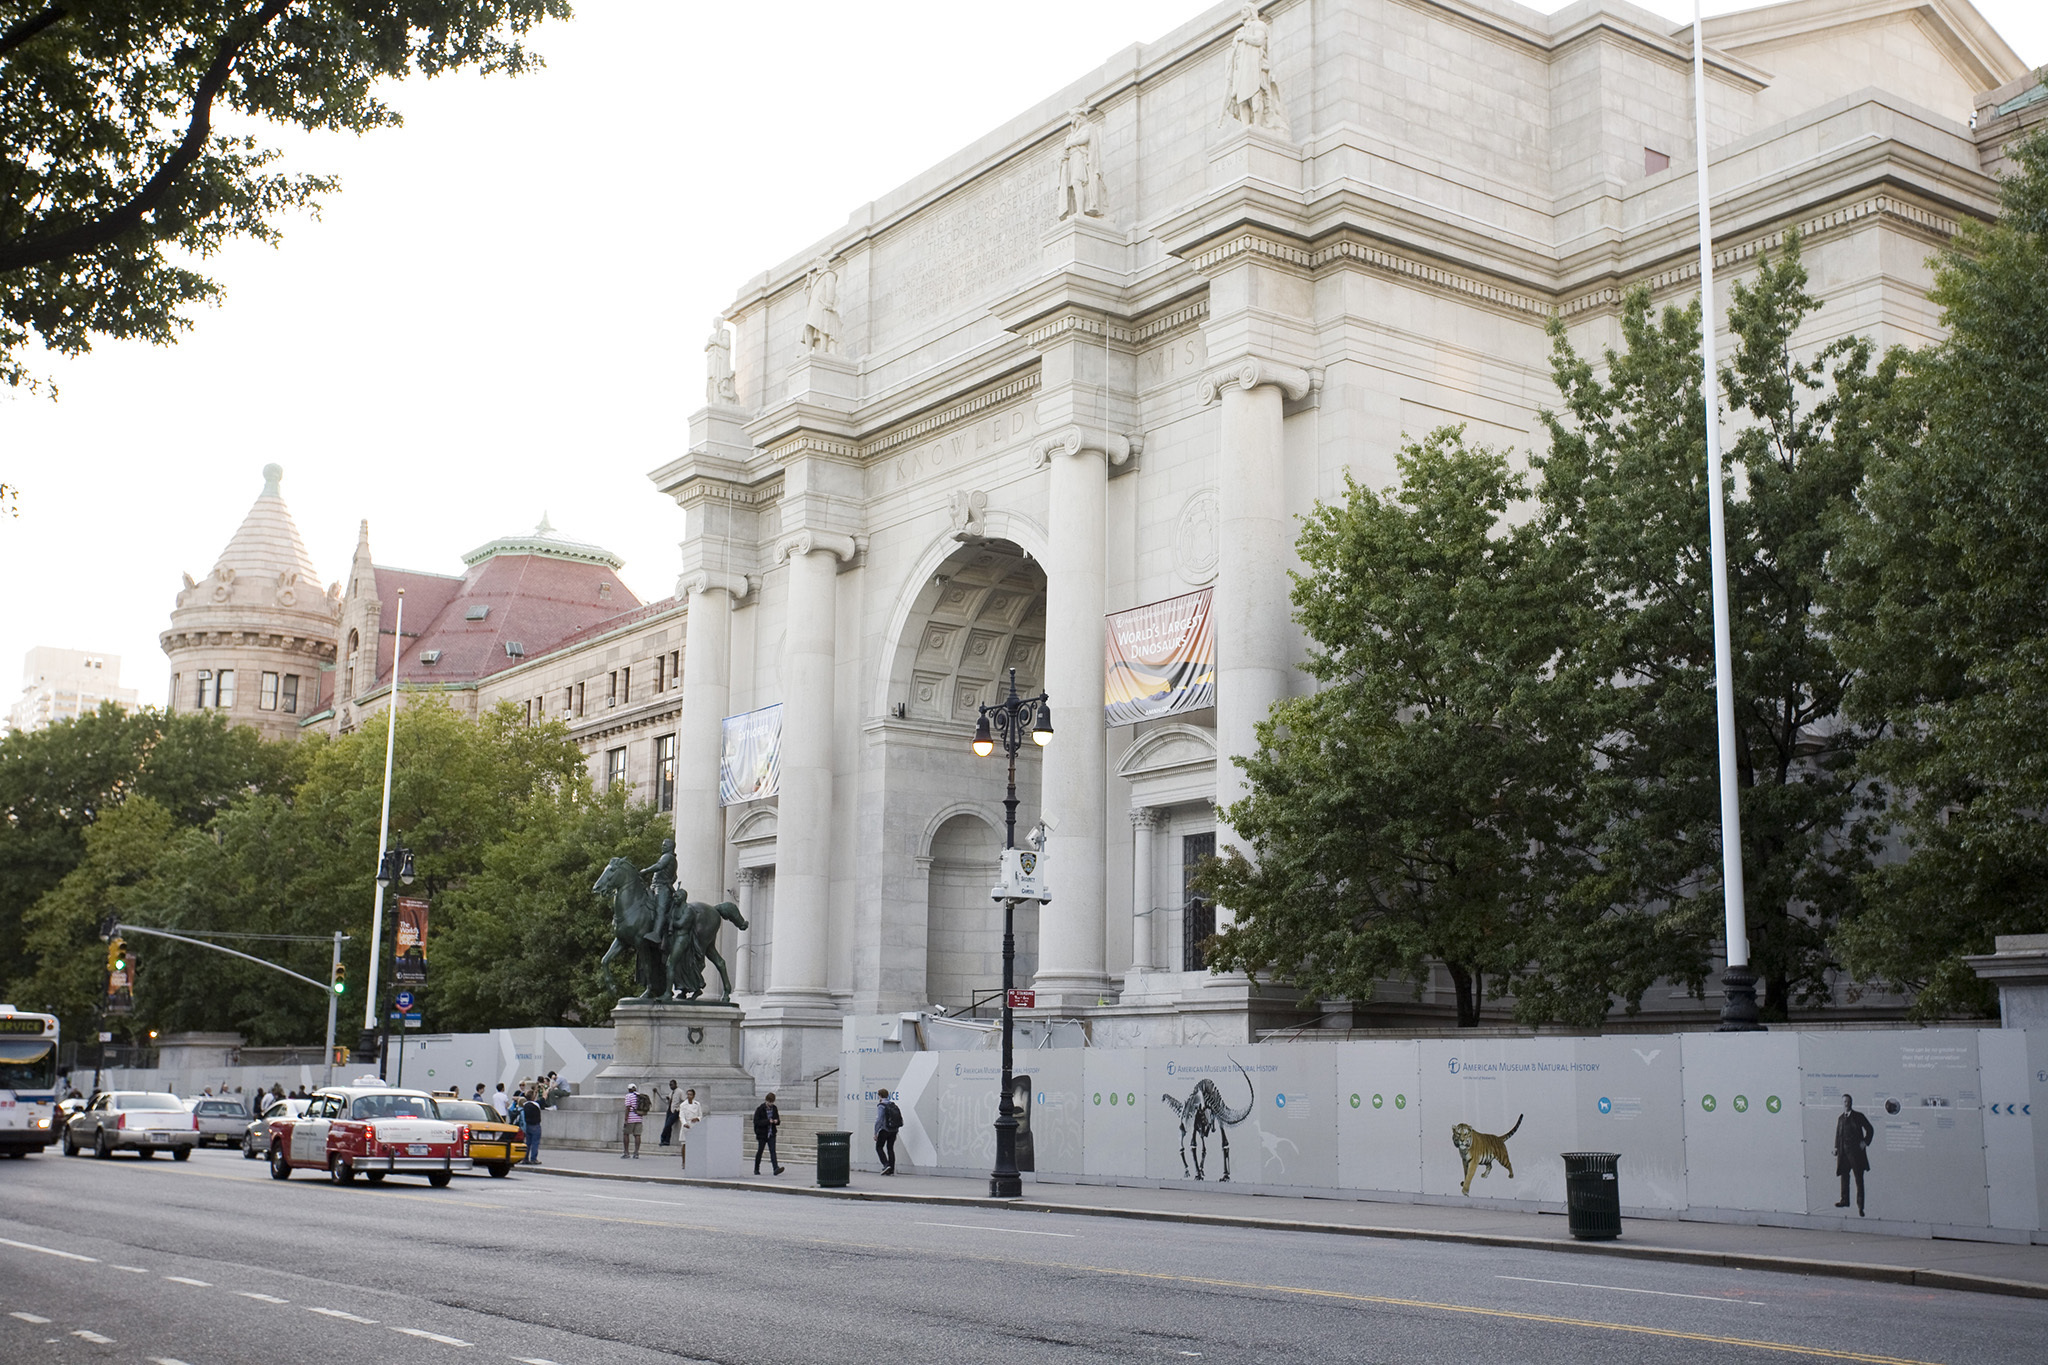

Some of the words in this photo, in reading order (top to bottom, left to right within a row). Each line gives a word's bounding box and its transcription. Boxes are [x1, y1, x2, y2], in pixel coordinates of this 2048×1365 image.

[911, 226, 935, 249] STATE
[937, 221, 949, 234] OF
[951, 209, 969, 227] NEW
[973, 196, 996, 215] YORK
[1000, 165, 1048, 198] MEMORIAL
[1025, 201, 1035, 215] OF
[928, 217, 980, 254] THEODORE
[984, 182, 1044, 221] ROOSEVELT
[1118, 623, 1160, 646] WORLD'S
[1162, 614, 1204, 635] LARGEST
[1131, 635, 1186, 659] DINOSAURS
[1023, 1066, 1040, 1074] HISTORY
[1256, 1064, 1278, 1072] HISTORY
[1537, 1062, 1569, 1071] NATURAL
[1570, 1062, 1600, 1071] HISTORY
[865, 1091, 899, 1101] ENTNCE
